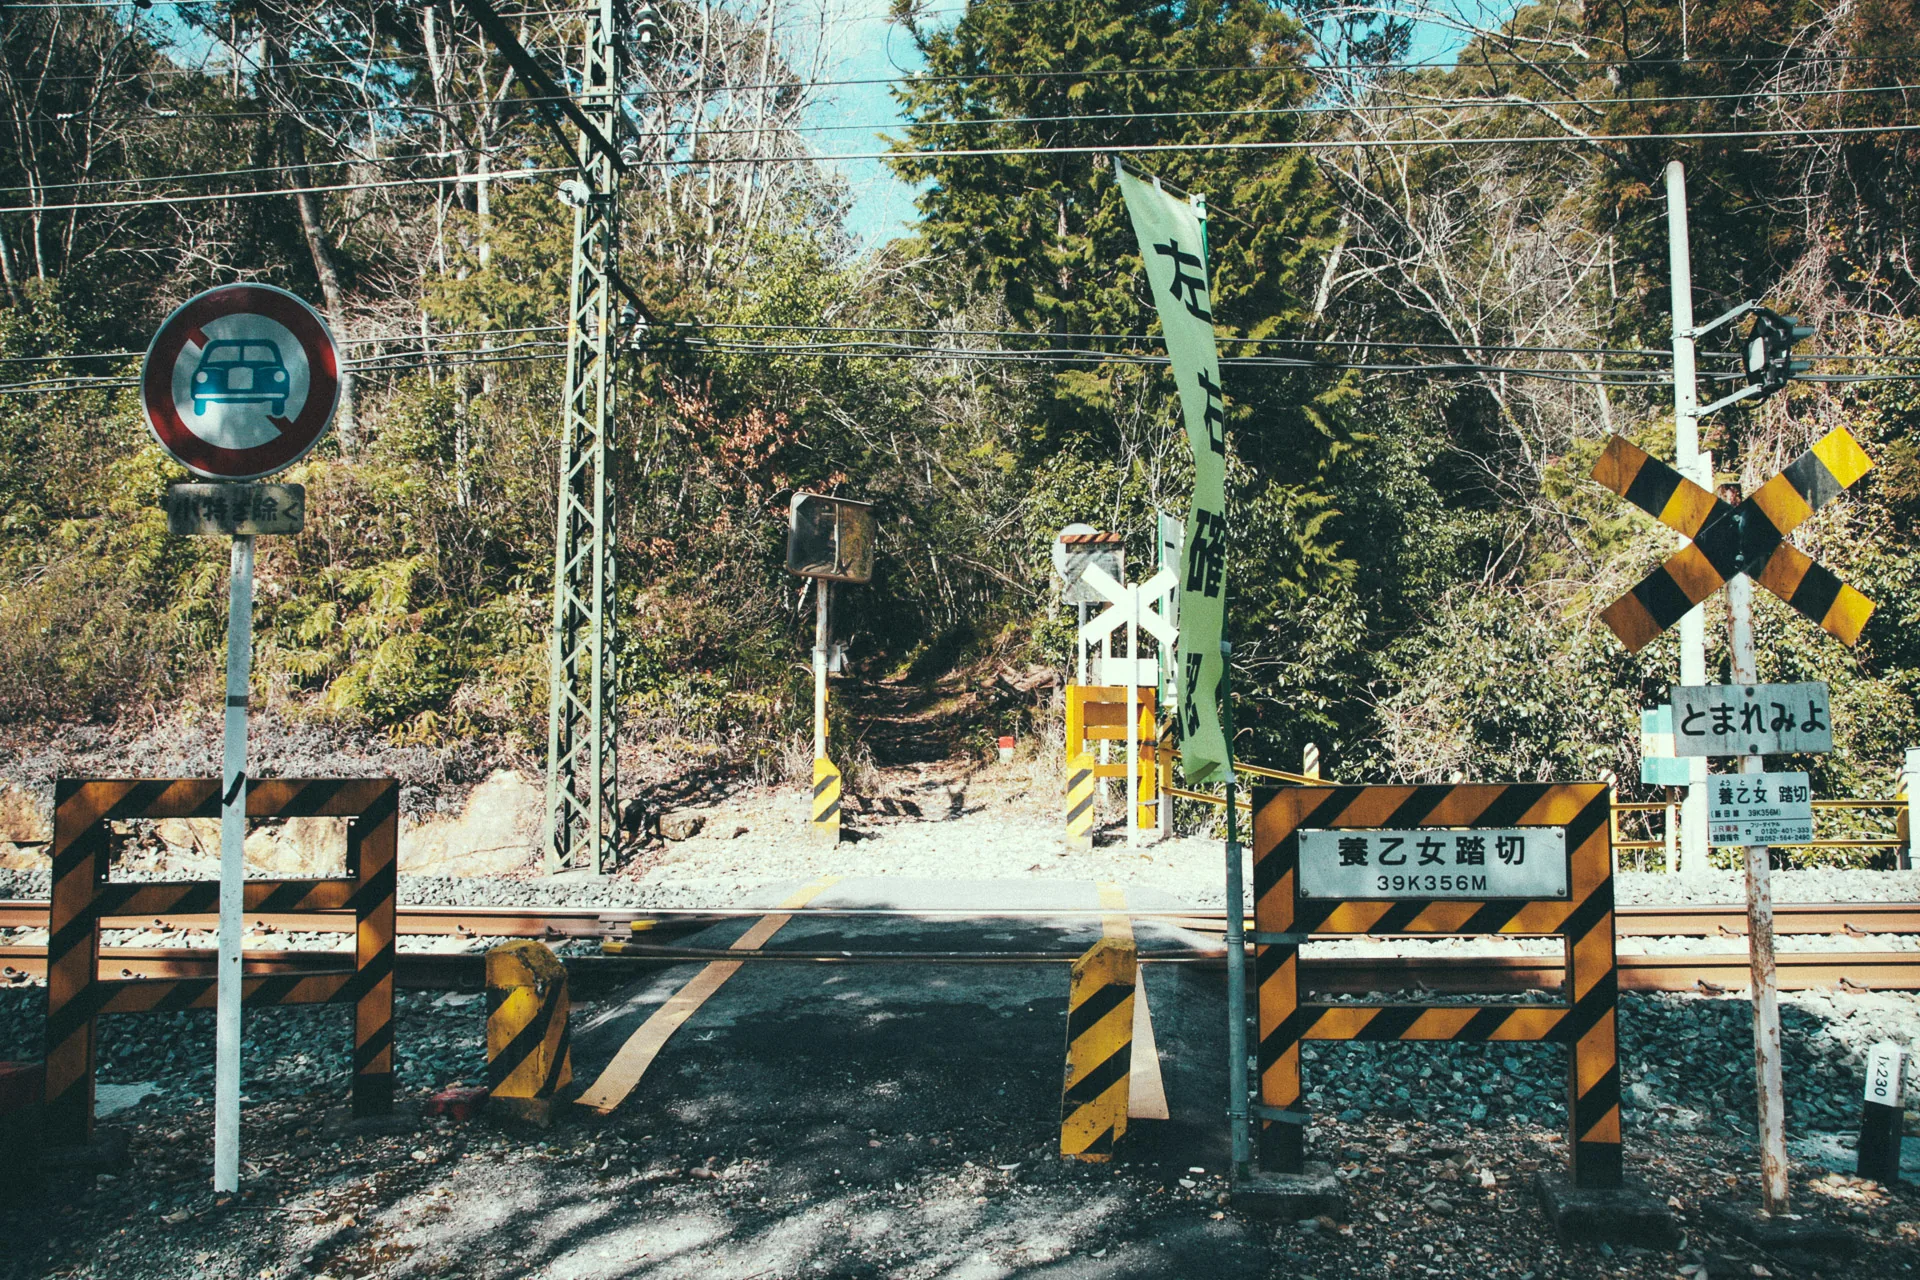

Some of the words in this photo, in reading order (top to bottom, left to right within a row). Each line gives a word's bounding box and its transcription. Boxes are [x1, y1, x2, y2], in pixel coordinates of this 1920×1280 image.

[1680, 700, 1827, 736] とまれみよ
[1779, 785, 1808, 803] 踏切
[1338, 835, 1525, 866] 養乙女踏切
[1377, 875, 1487, 891] 39K356M
